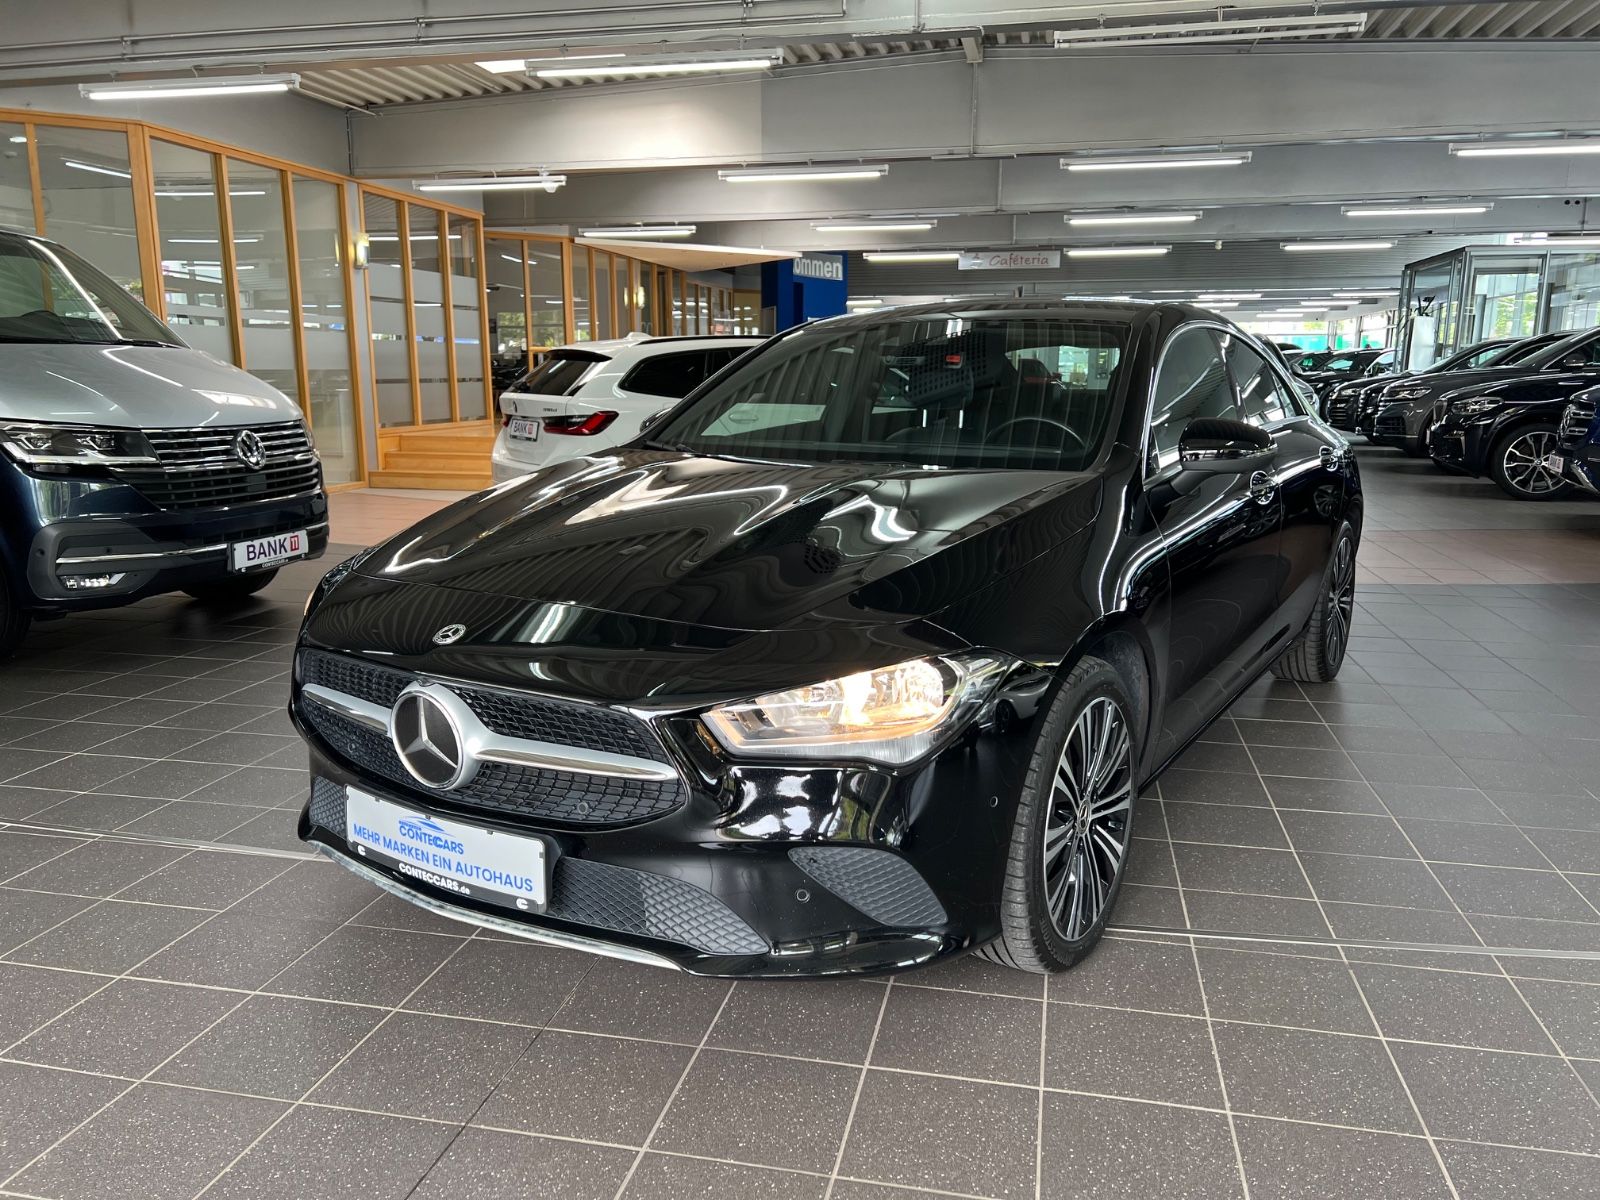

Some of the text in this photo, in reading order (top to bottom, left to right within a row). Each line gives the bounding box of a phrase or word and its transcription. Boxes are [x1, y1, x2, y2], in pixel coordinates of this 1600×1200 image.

[989, 252, 1049, 268] Caféteria
[246, 537, 288, 561] BANK
[399, 825, 465, 855] CONTECCARS
[353, 823, 381, 845] MEHR
[383, 836, 430, 864] MARKEN
[432, 853, 452, 871] EIN
[455, 861, 533, 892] AUTOHAUS
[398, 862, 471, 895] CONTECCARS.de
